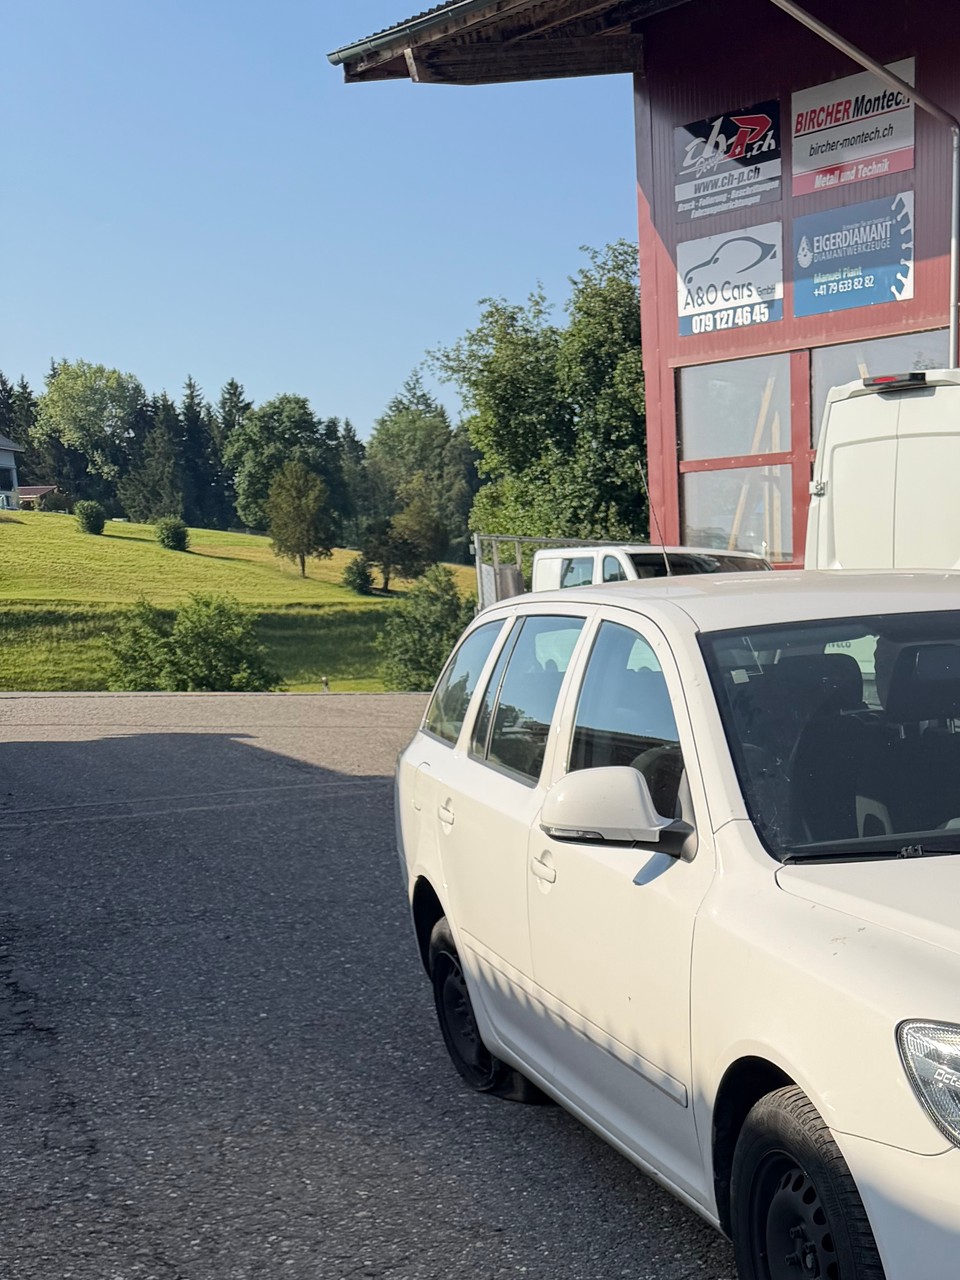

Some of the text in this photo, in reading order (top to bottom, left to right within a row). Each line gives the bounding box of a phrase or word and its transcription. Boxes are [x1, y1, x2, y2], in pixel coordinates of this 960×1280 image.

[794, 99, 852, 134] BIRCHER
[808, 123, 894, 157] bircher-montech.ch
[693, 165, 761, 195] www.ch-p.ch
[814, 158, 890, 188] Metall und Technik
[813, 220, 892, 254] EIGERDIAMANT
[813, 237, 891, 263] DIAMANTWERKZEUGE
[683, 283, 718, 310] A&O
[720, 280, 753, 303] Cars
[813, 275, 874, 297] +41 79 633 82 82
[692, 302, 770, 334] 079 127 46 45
